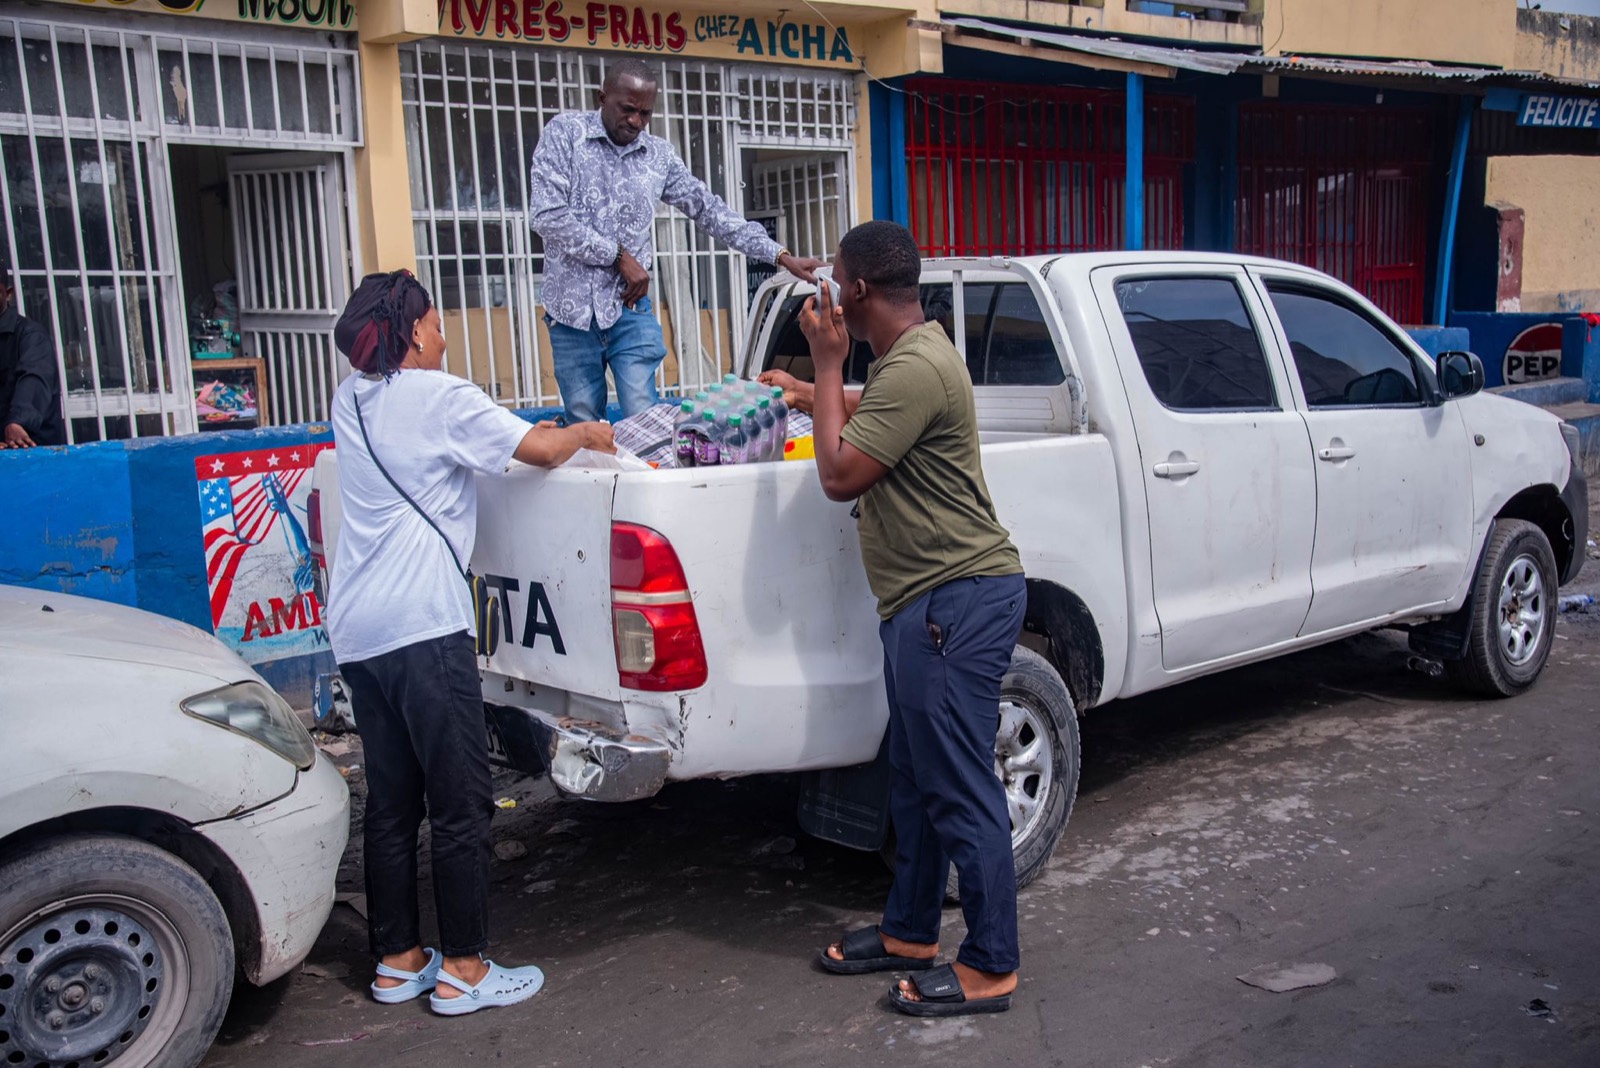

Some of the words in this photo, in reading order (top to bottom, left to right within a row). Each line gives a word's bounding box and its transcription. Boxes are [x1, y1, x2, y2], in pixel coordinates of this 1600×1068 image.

[438, 0, 688, 52] IVRES-FRAIS
[695, 15, 739, 42] CHEZ
[737, 17, 853, 63] AICHA
